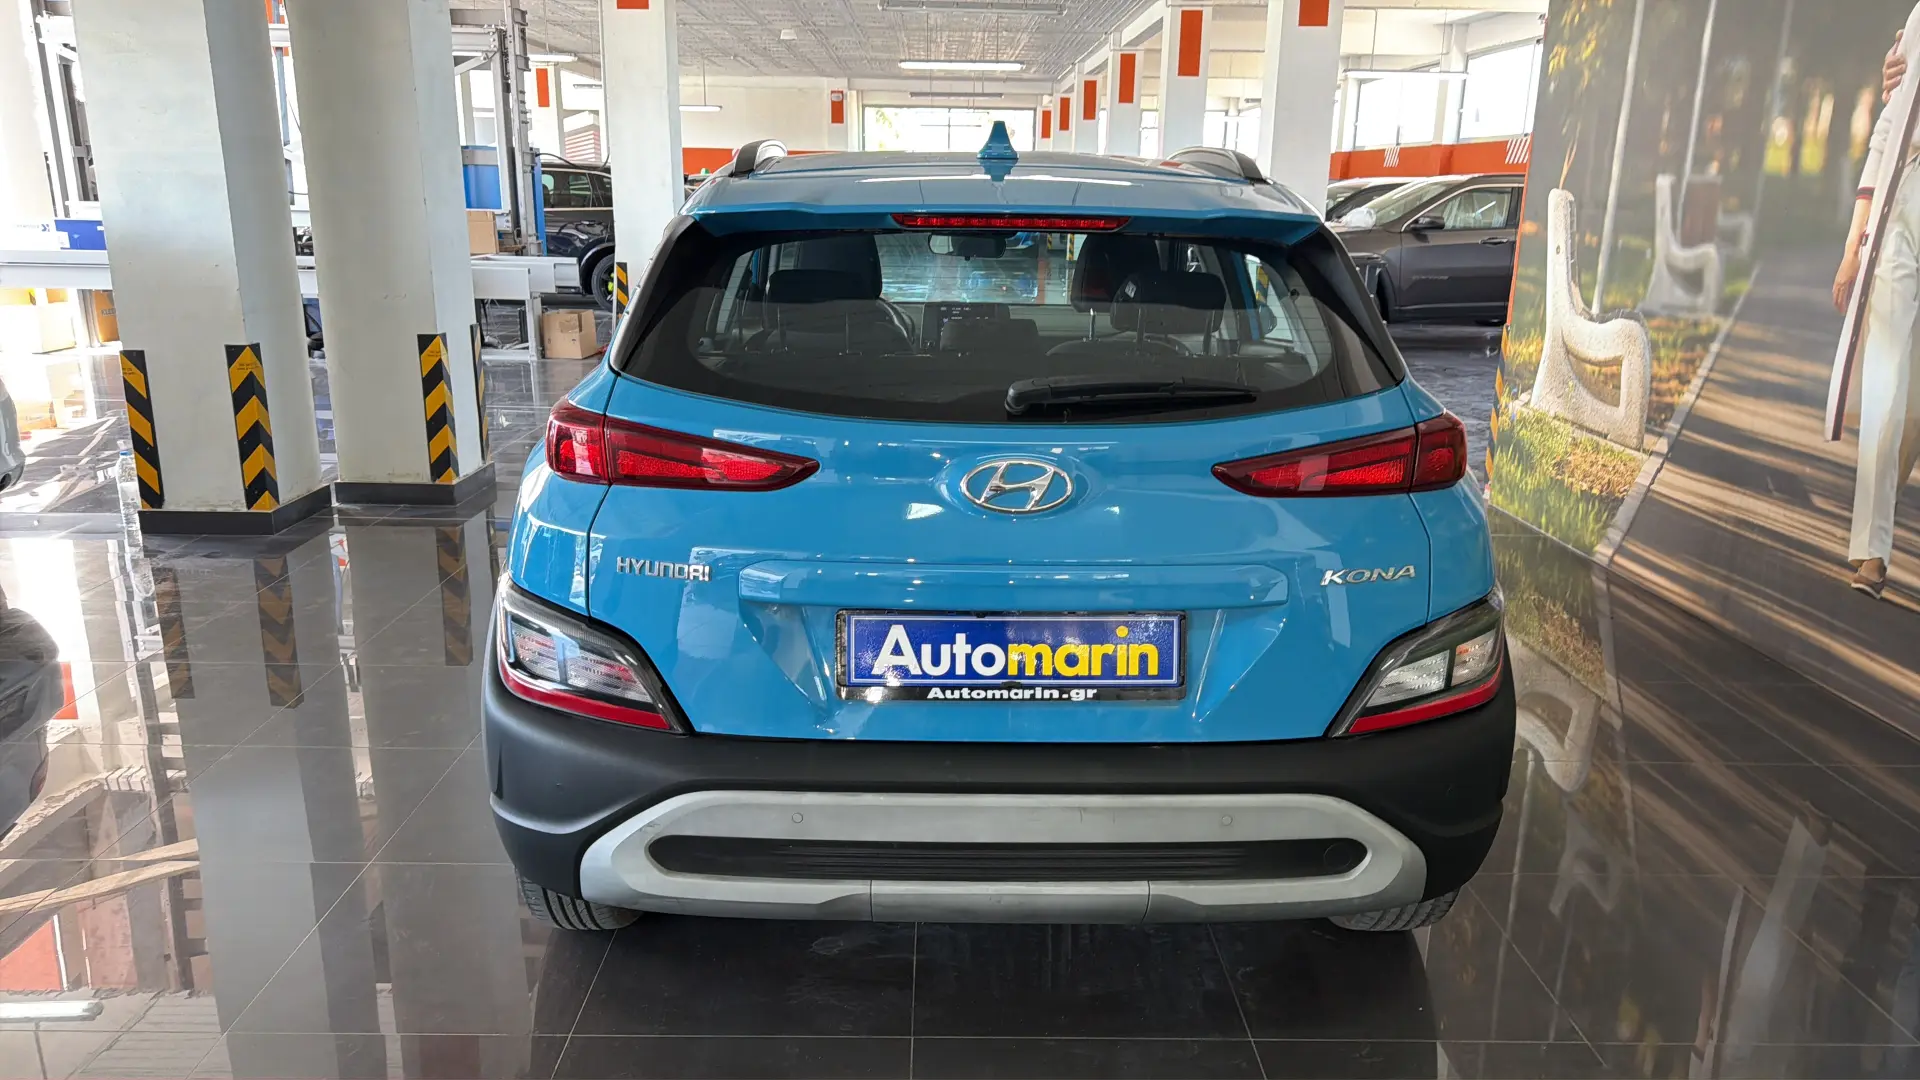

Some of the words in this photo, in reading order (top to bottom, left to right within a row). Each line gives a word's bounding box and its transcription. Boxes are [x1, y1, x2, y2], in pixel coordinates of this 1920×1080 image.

[616, 556, 710, 581] HYUNDAI
[1320, 565, 1416, 586] KONA
[871, 624, 1159, 677] Automarin
[927, 687, 1097, 701] Automarin.gr
